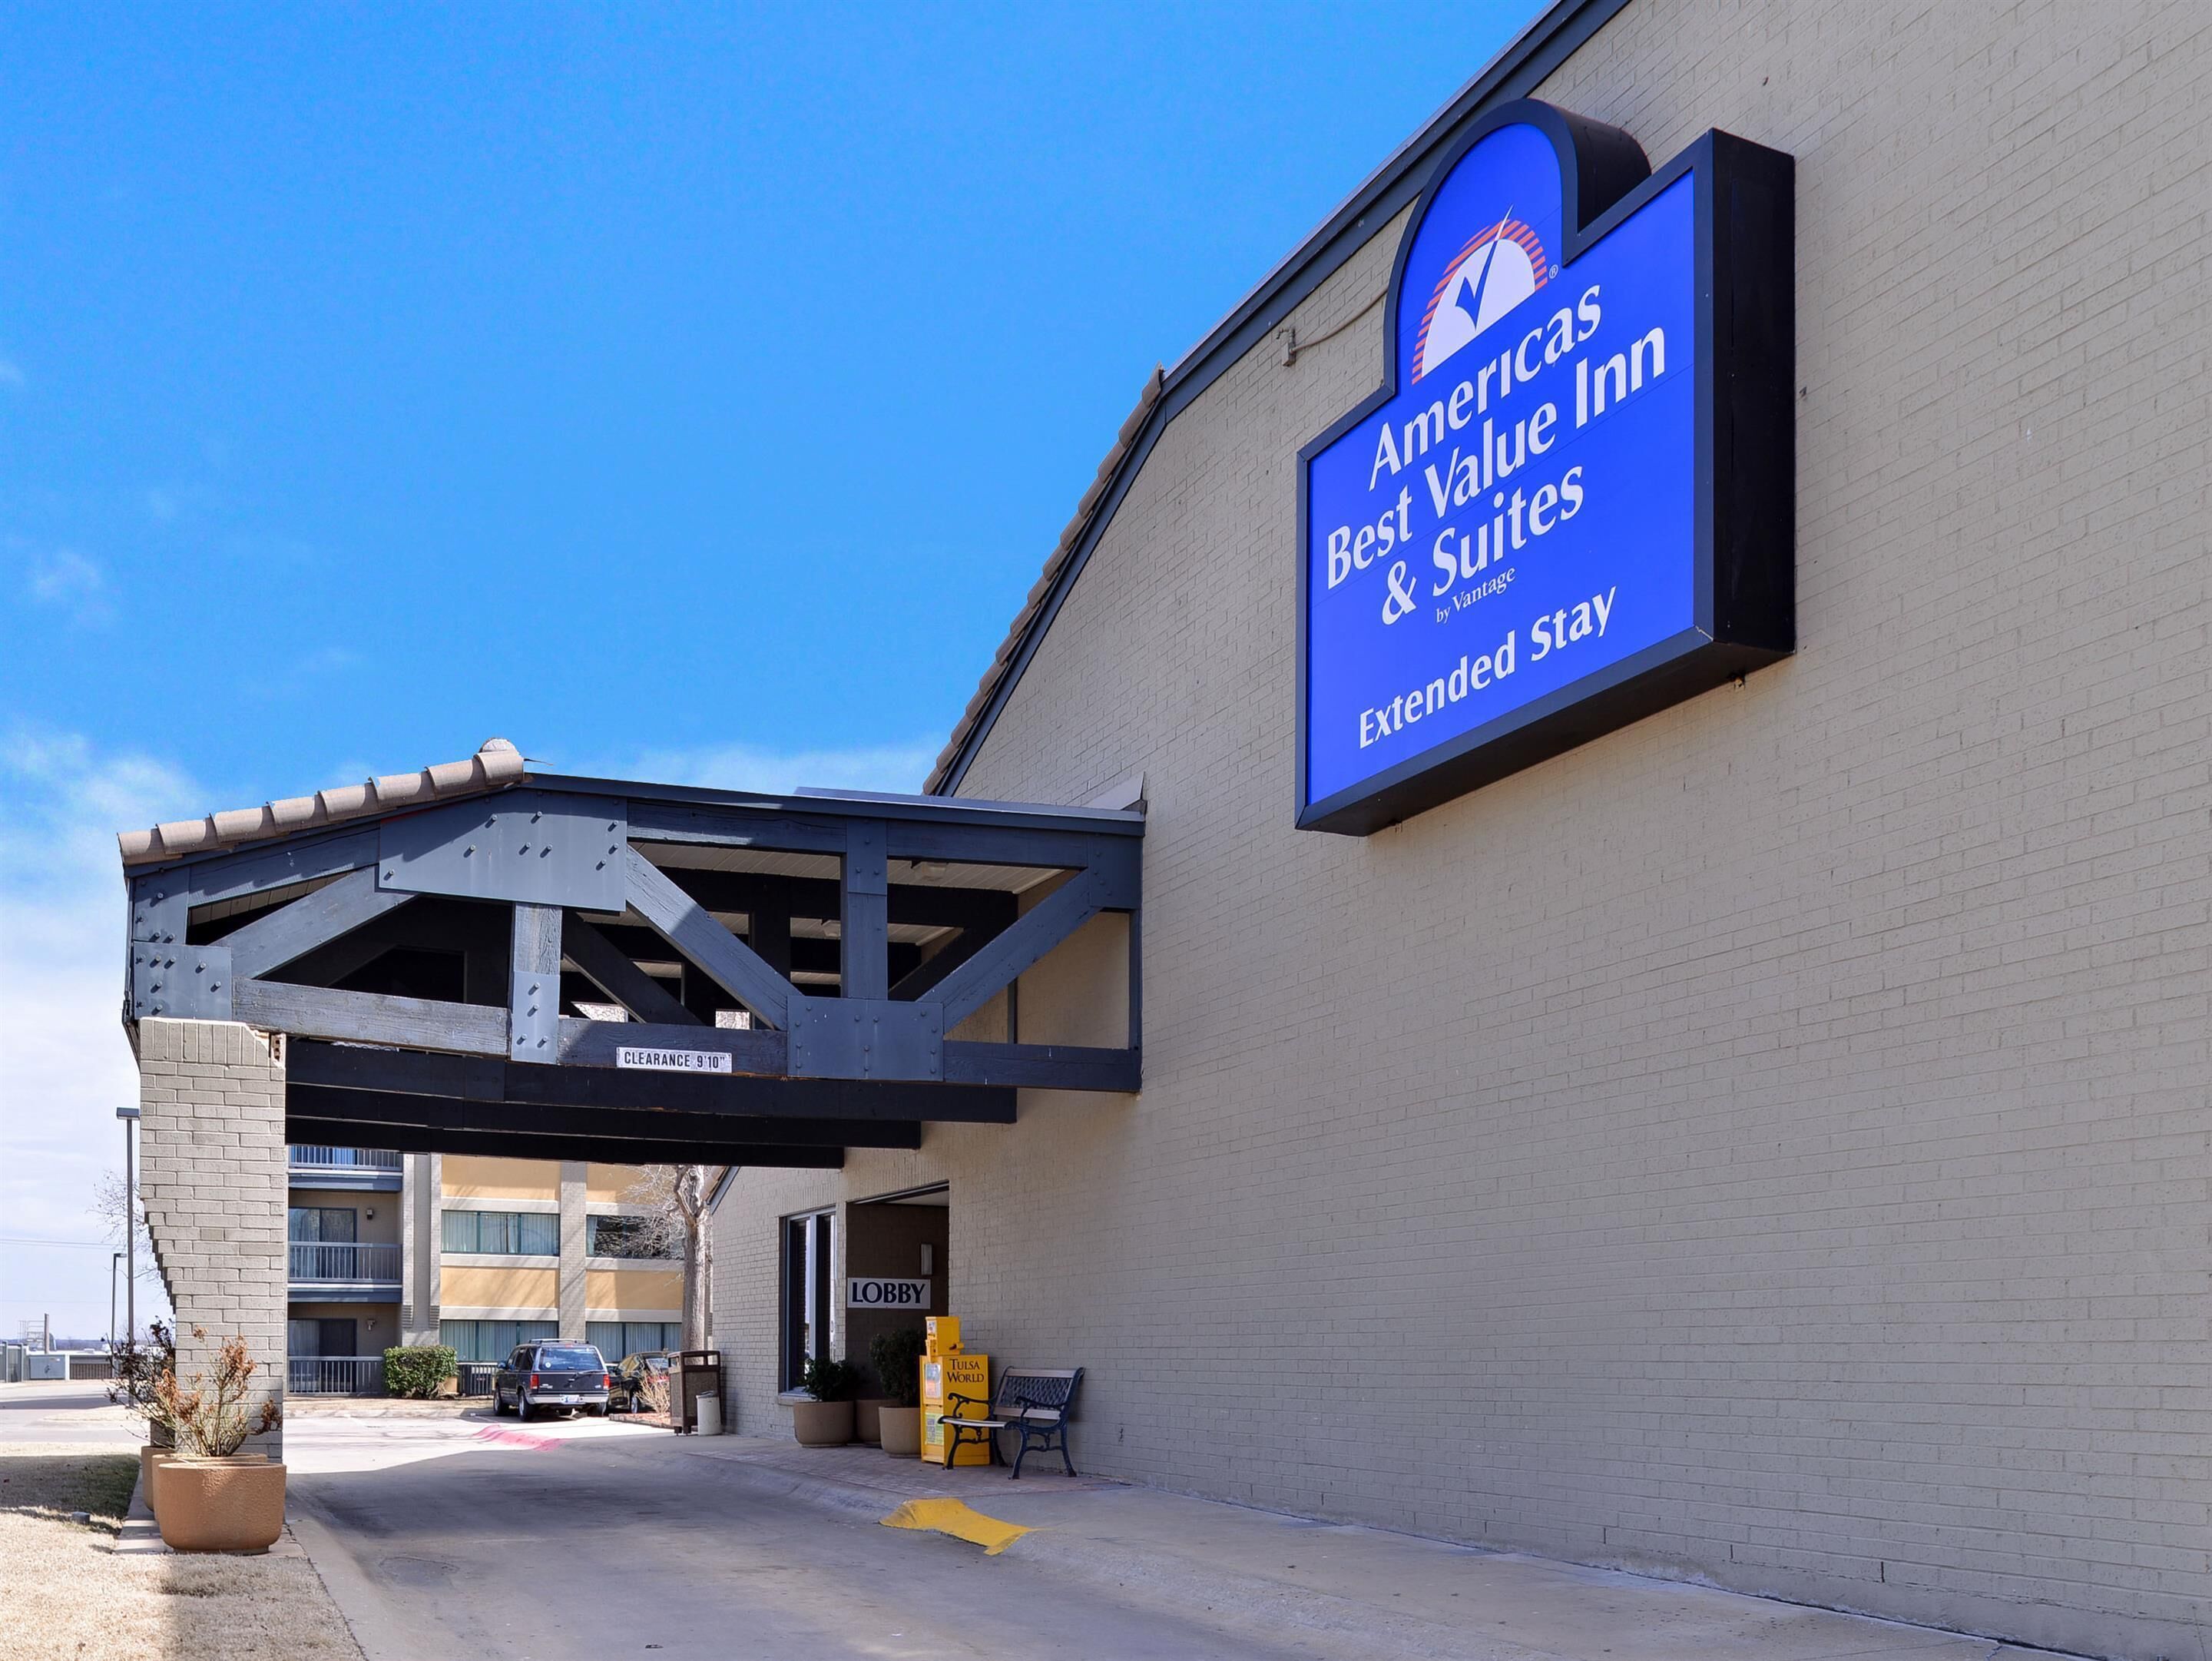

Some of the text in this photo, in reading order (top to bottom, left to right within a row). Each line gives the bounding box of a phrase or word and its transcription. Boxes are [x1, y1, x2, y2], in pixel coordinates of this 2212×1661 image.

[1369, 284, 1602, 492] Americas
[1328, 327, 1665, 590] Best Value Inn
[1382, 466, 1584, 626] & Suites
[1435, 565, 1515, 624] by Vantage
[1359, 586, 1617, 750] Extended Stay
[624, 1051, 690, 1067] CLEARANCE
[851, 1281, 926, 1304] LOBBY
[947, 1371, 985, 1383] WORLD
[949, 1358, 980, 1371] TULSA
